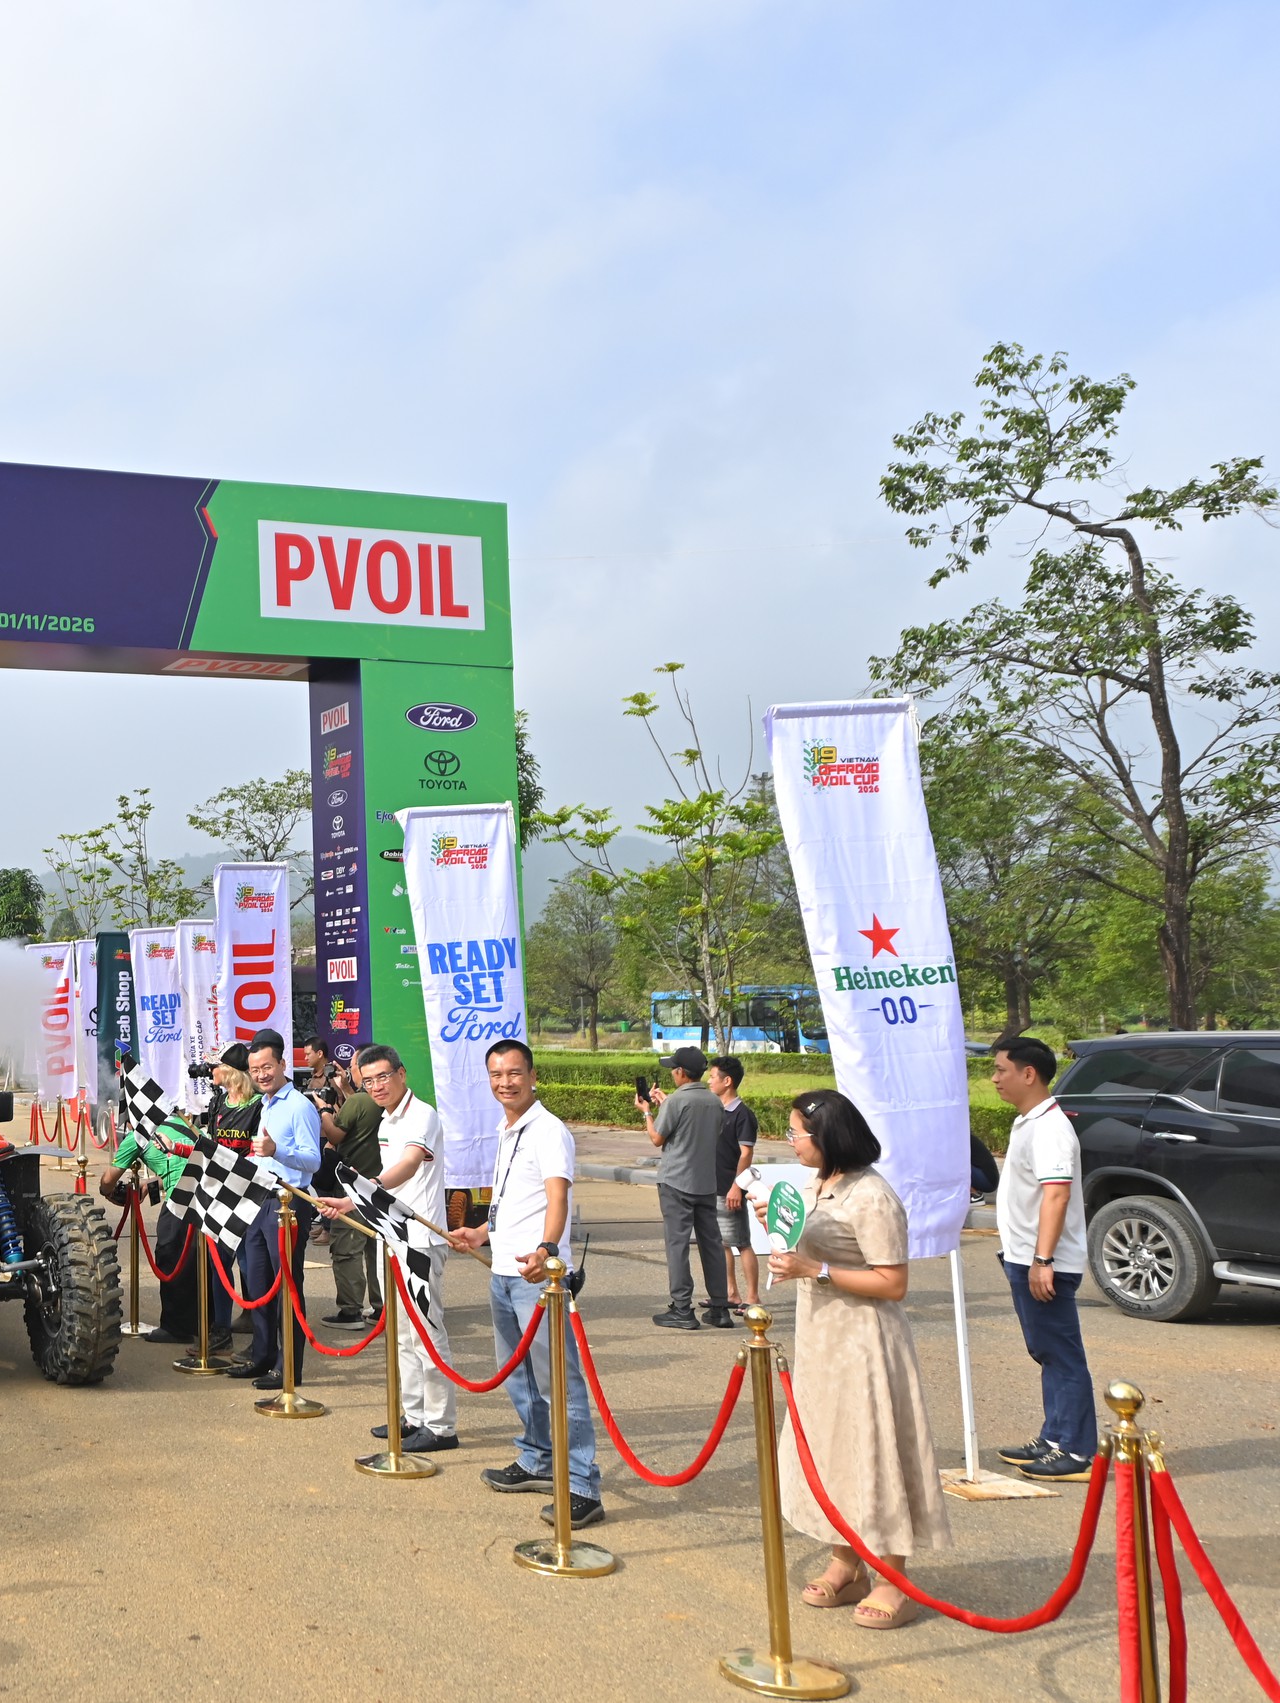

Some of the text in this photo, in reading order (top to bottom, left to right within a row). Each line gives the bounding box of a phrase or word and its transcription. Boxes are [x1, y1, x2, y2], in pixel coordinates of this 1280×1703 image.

[274, 532, 470, 618] PVOIL
[175, 660, 289, 674] PVOIL
[322, 705, 348, 732] PVOIL
[420, 706, 463, 728] Ford
[811, 746, 837, 764] 19
[819, 763, 879, 775] OFFROAD
[419, 779, 467, 790] TOYOTA
[812, 774, 879, 786] PVOIL CUP
[438, 837, 458, 849] 19
[443, 848, 488, 857] OFFROAD
[436, 857, 466, 866] PVOIL
[427, 937, 516, 975] READY
[329, 960, 355, 980] PVOIL
[832, 963, 955, 992] Heineken
[116, 971, 132, 1012] Shop
[232, 929, 277, 1042] OIL
[452, 971, 505, 1006] SET
[41, 978, 74, 1076] PVOIL
[152, 1009, 176, 1026] SET
[440, 1005, 521, 1042] Ford
[145, 1026, 182, 1043] Ford
